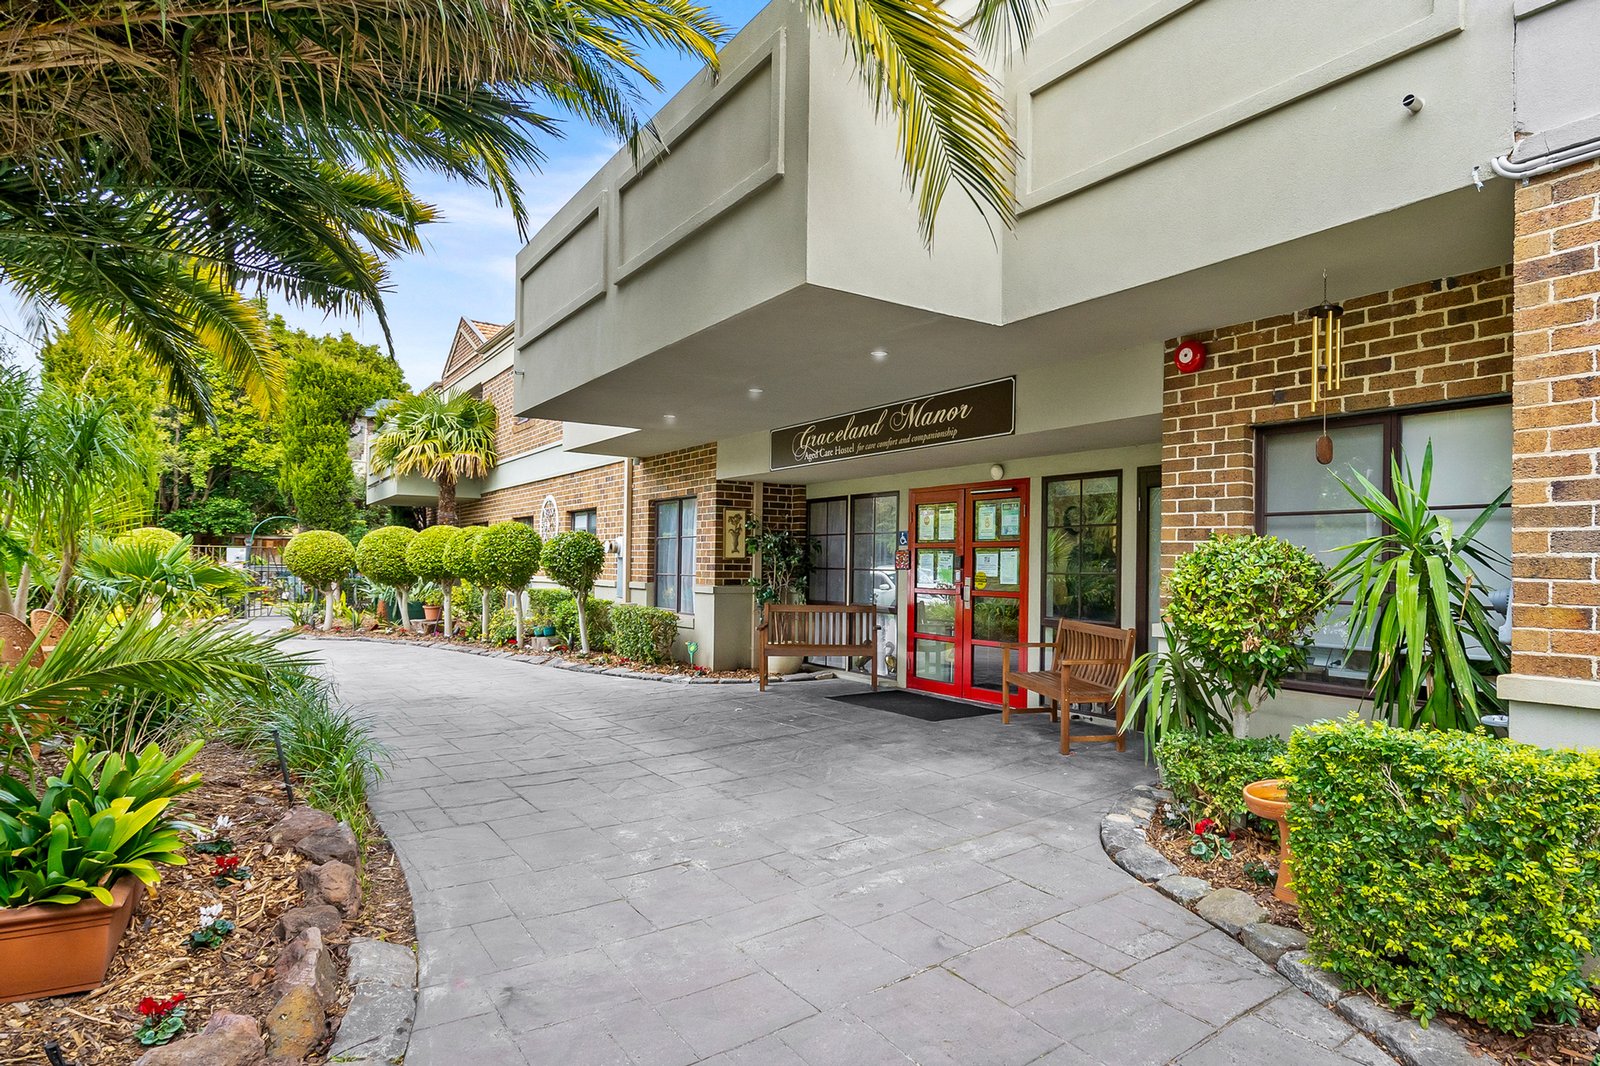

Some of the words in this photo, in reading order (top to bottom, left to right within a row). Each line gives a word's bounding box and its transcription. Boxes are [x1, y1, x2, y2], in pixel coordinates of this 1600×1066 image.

[792, 408, 889, 461] Graceland
[889, 397, 973, 432] Manor
[804, 450, 820, 462] Aged
[819, 446, 834, 457] Care
[834, 444, 855, 456] Hostel
[855, 443, 865, 454] for
[864, 442, 876, 451] care
[876, 437, 899, 451] comfort
[899, 435, 911, 445] and
[911, 427, 958, 444] companionship
